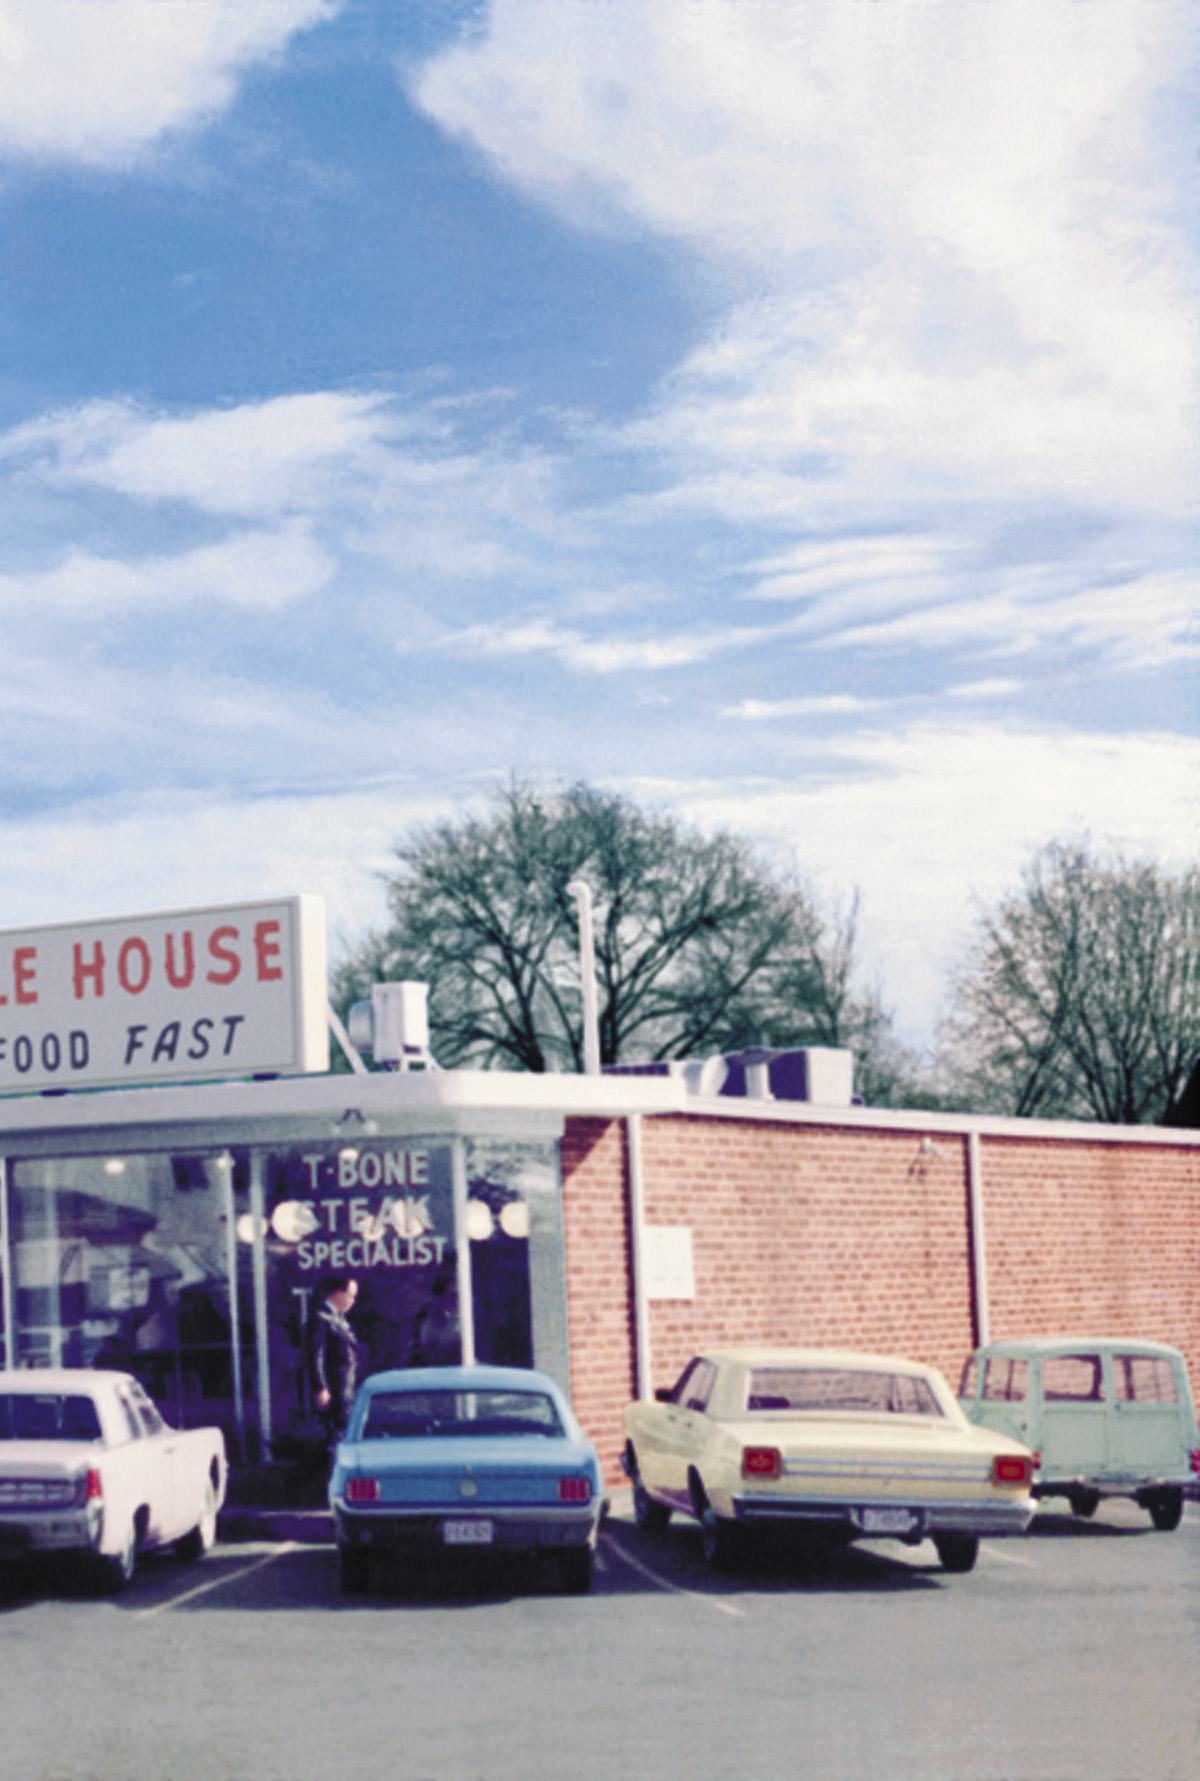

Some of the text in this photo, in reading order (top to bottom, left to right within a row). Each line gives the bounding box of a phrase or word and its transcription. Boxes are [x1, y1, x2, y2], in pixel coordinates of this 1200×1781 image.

[72, 920, 284, 1000] HOUSE
[123, 1015, 245, 1065] FAST
[294, 1194, 435, 1234] STEAK
[297, 1237, 448, 1271] SPECIALIST
